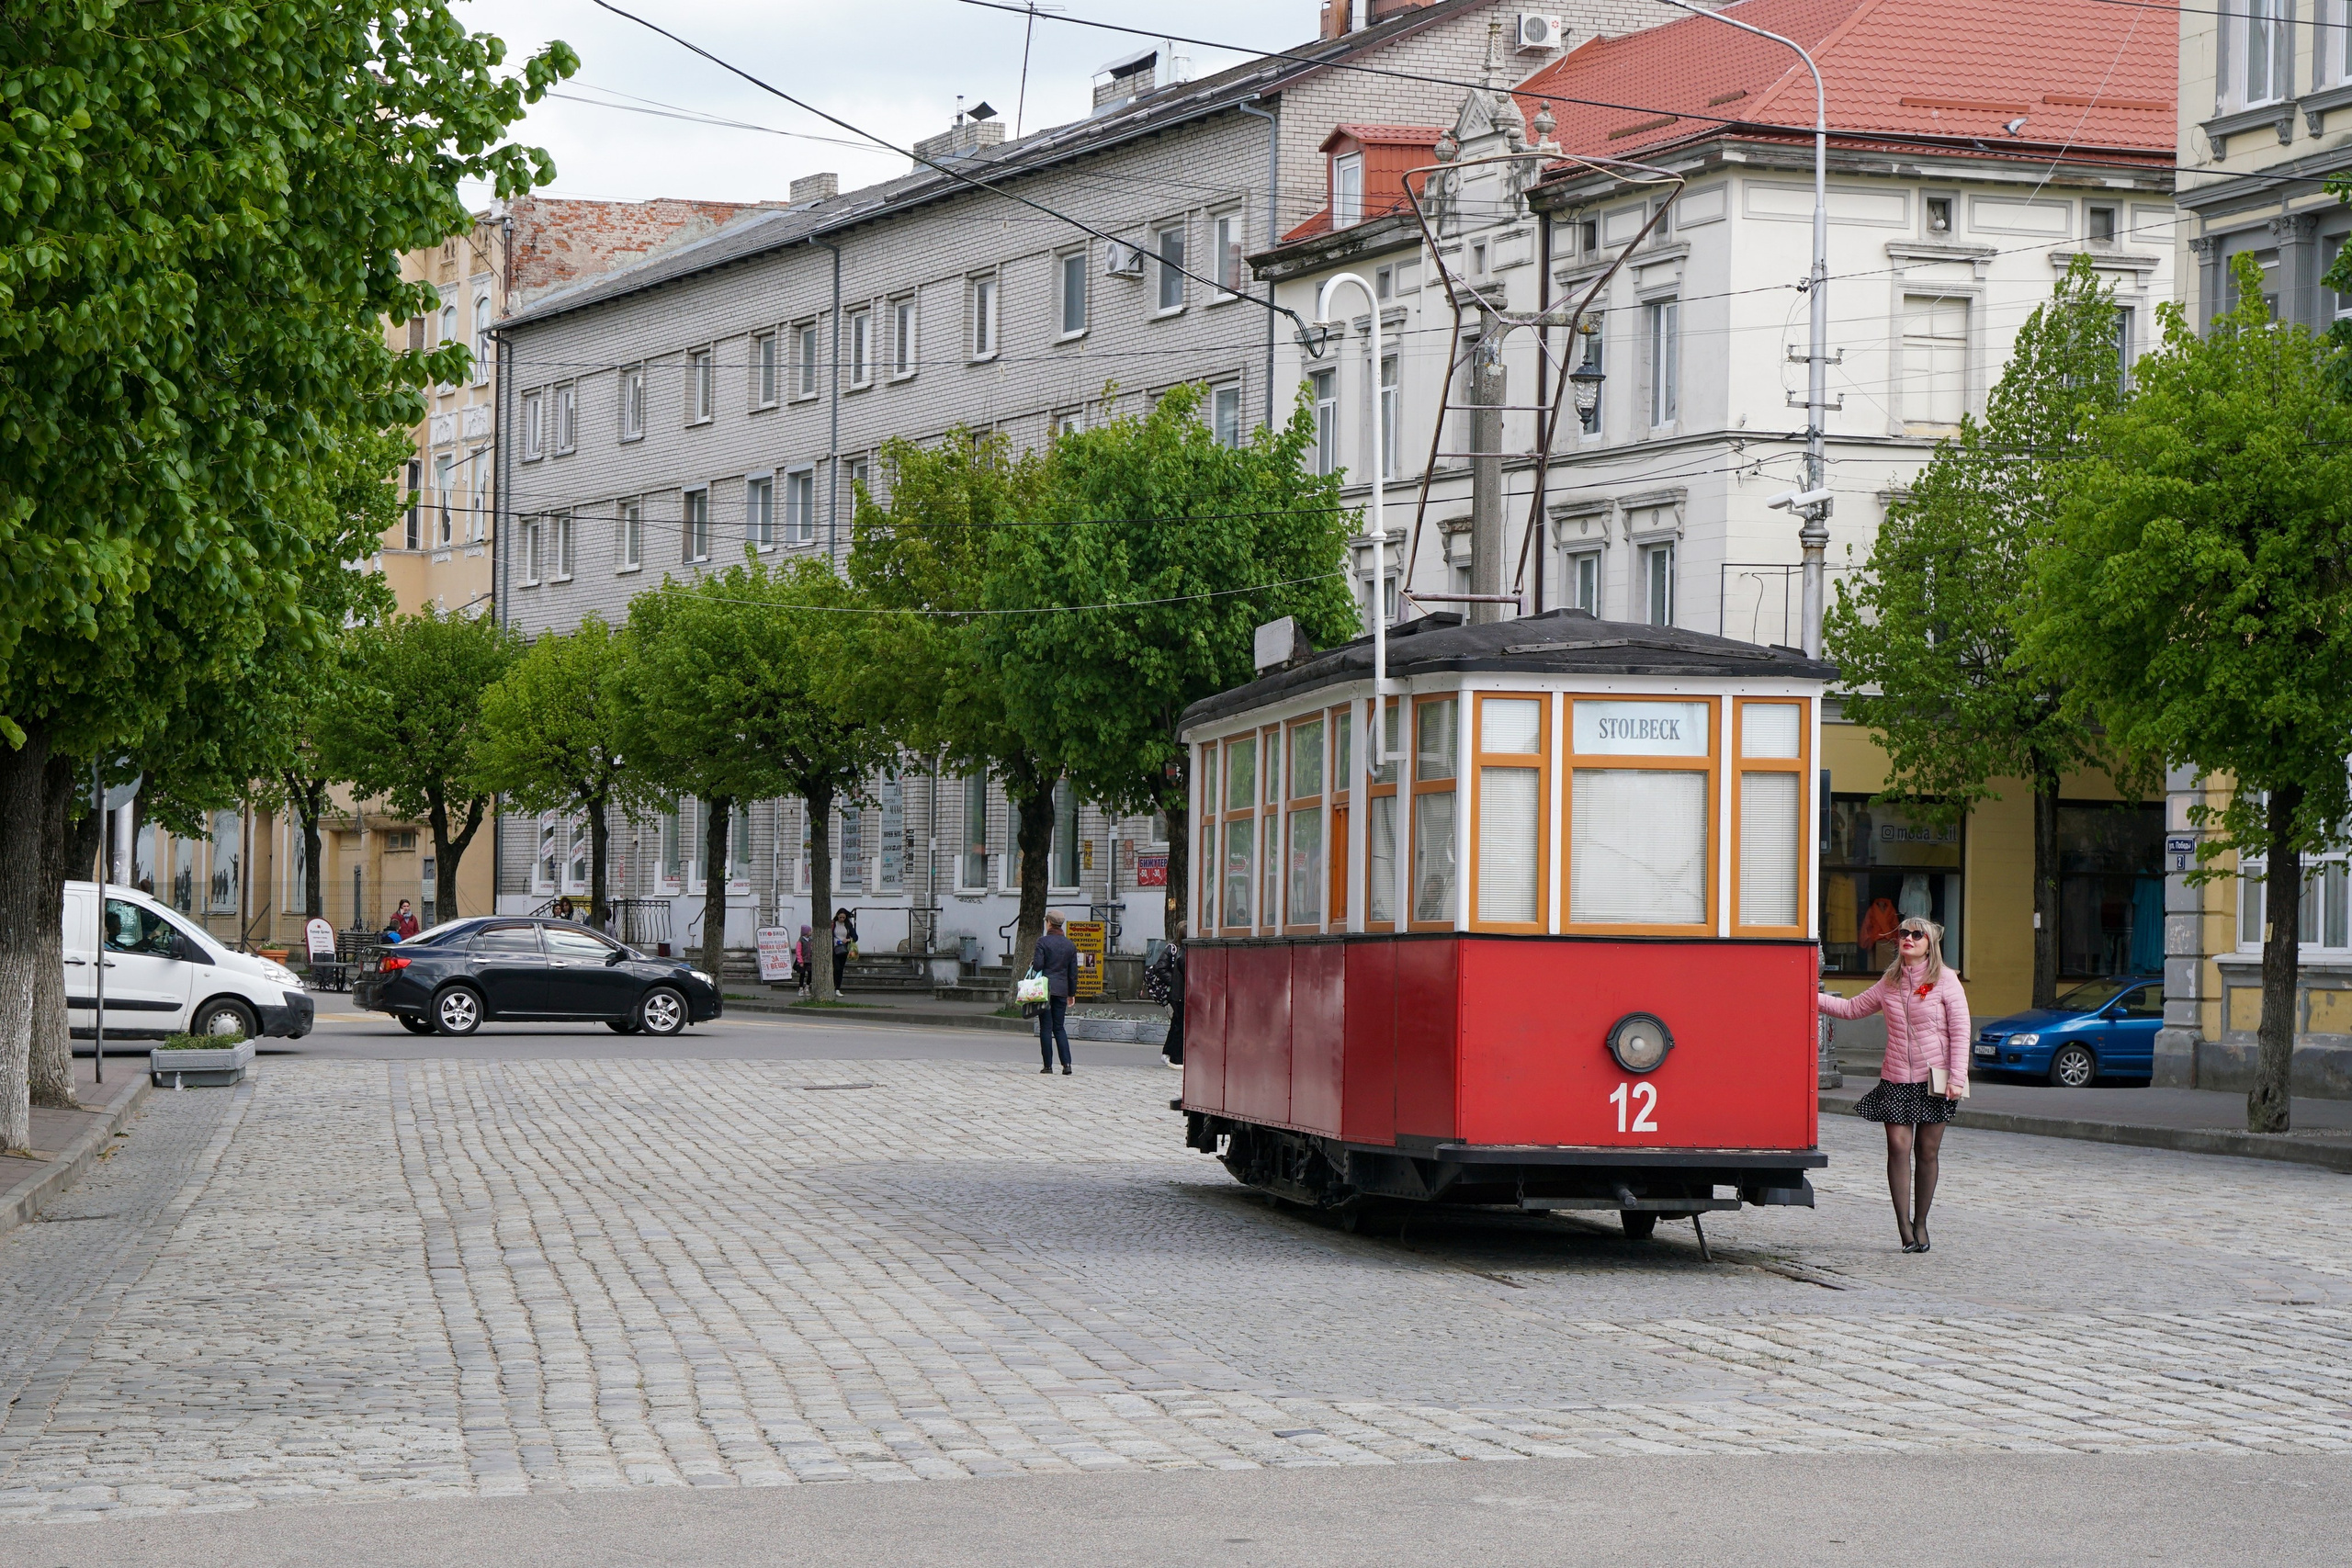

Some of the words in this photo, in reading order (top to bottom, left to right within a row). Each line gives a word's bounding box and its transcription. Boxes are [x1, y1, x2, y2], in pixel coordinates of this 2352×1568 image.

[1599, 717, 1680, 740] STOLBECK
[2176, 841, 2191, 850] Победы
[1139, 858, 1168, 868] БИЖУТЕР
[2178, 857, 2182, 867] 2
[1610, 1081, 1657, 1133] 12
